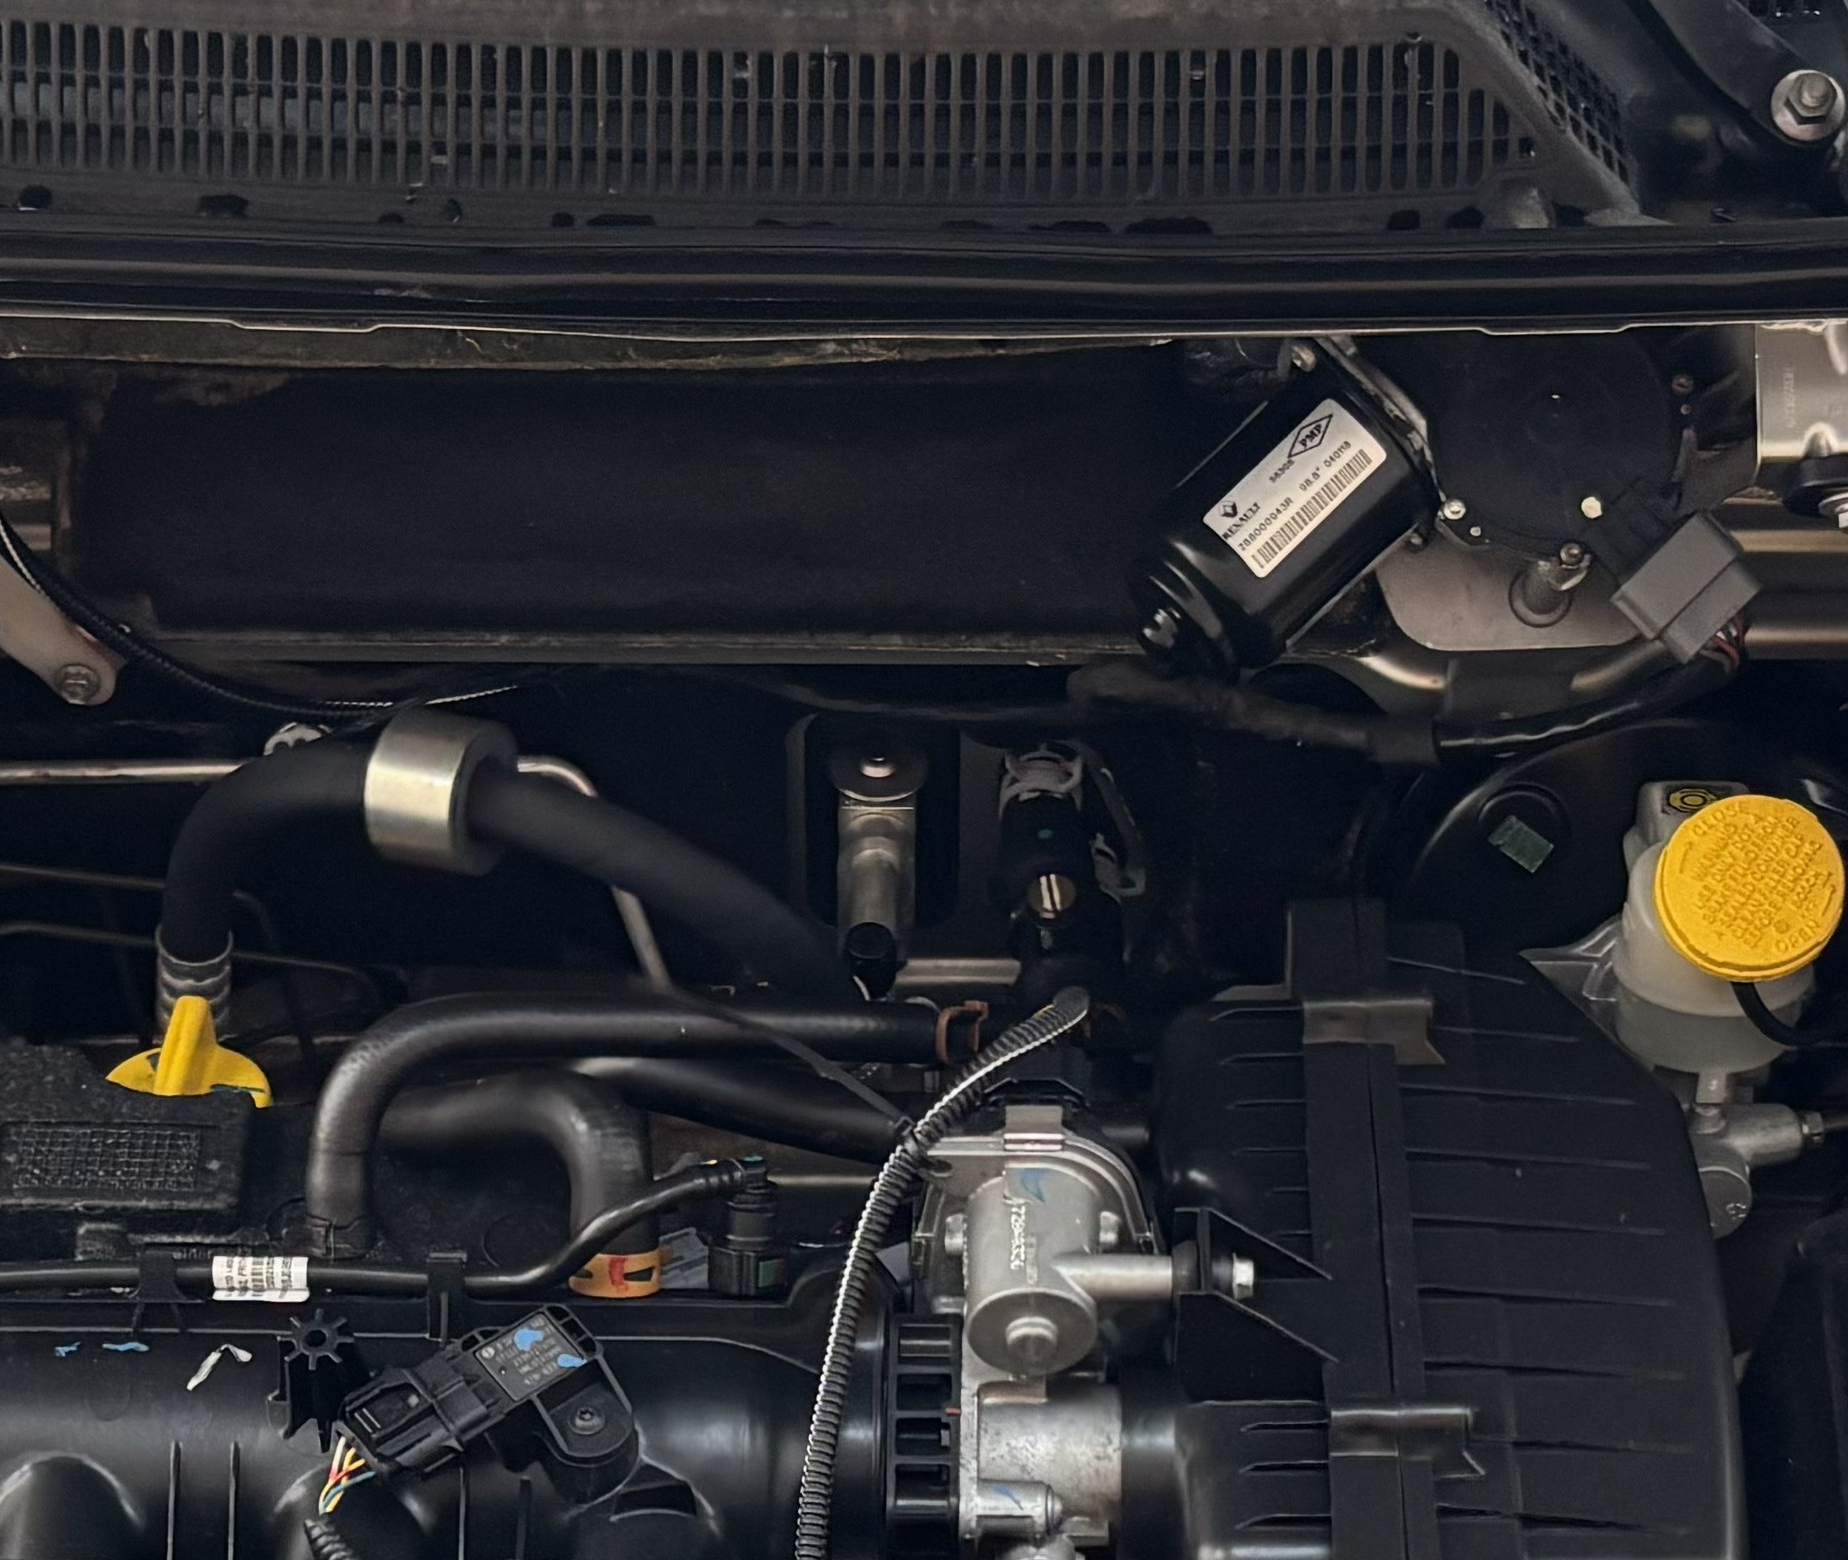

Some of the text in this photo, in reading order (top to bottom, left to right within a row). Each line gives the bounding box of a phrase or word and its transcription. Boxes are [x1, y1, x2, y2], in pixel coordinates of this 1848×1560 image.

[1298, 422, 1325, 448] PMP
[1221, 501, 1261, 540] RENAULT
[1691, 820, 1737, 884] WARNING
